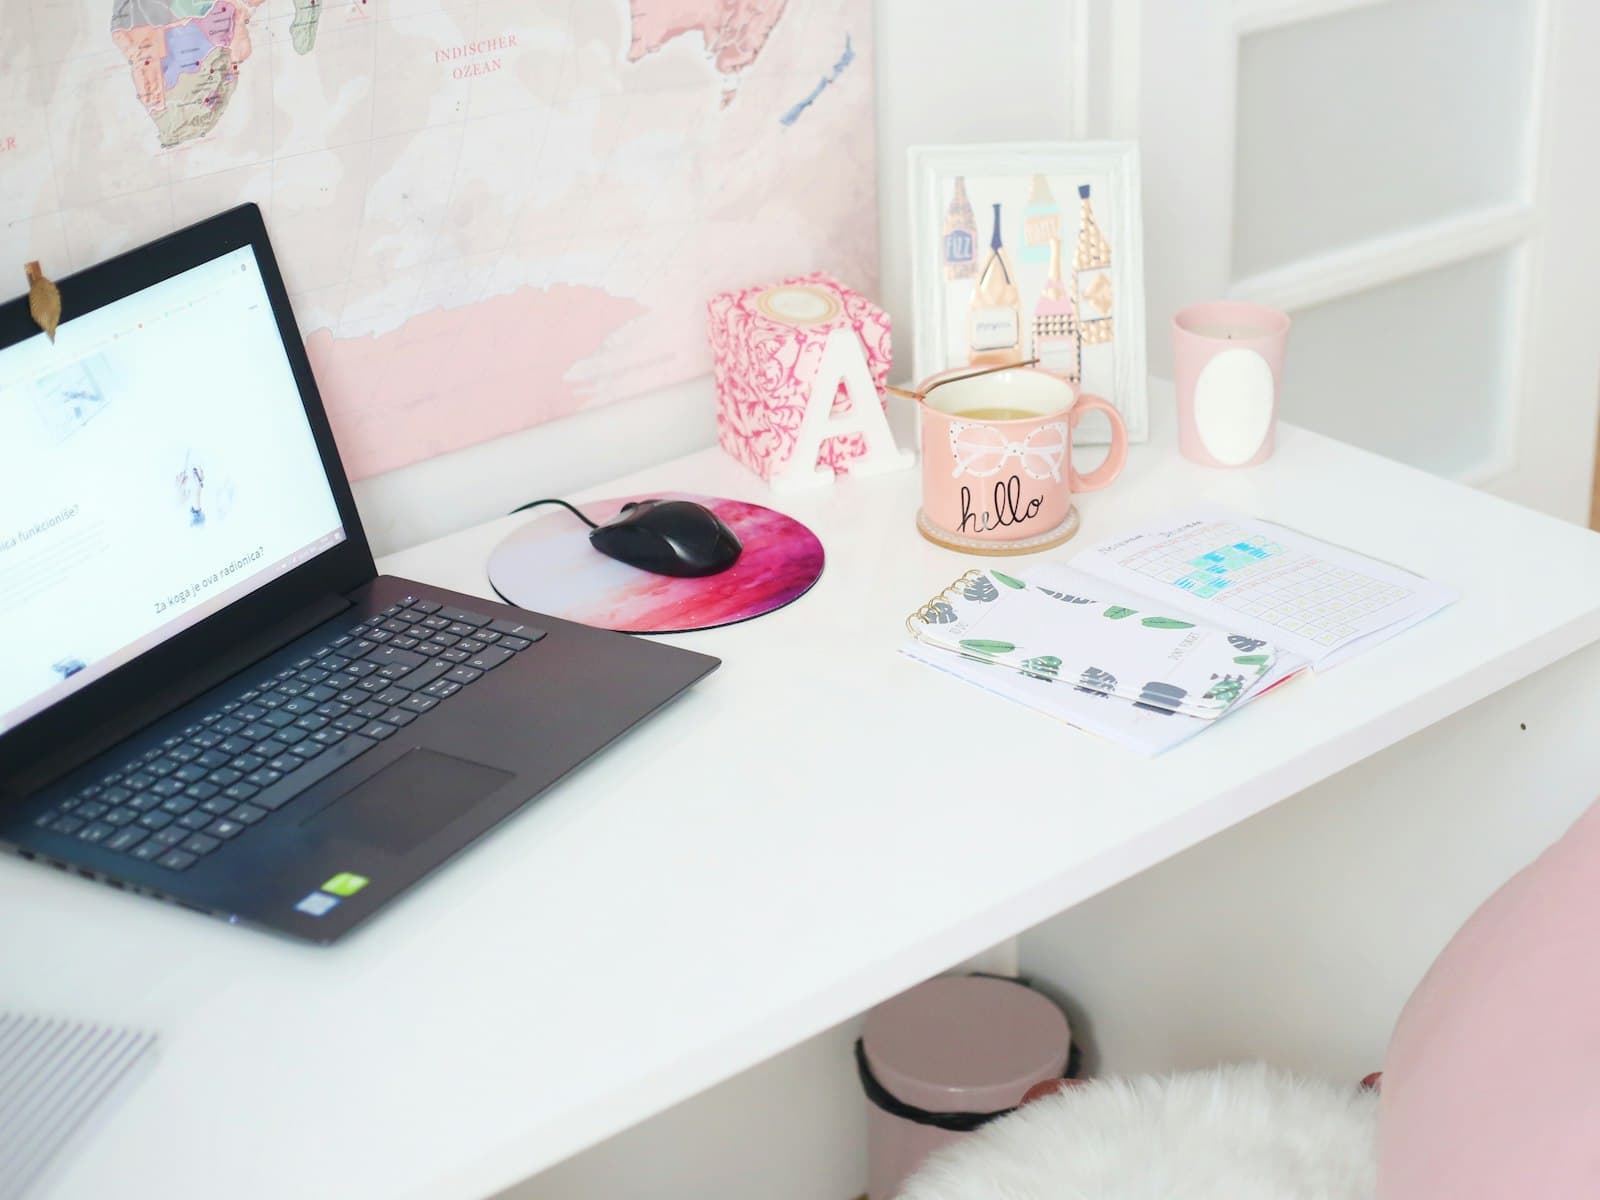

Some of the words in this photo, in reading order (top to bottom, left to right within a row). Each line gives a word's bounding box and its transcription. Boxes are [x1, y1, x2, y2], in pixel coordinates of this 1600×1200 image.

[433, 33, 518, 65] INDISCHER
[452, 58, 502, 80] OZEAN
[769, 327, 915, 490] A
[956, 475, 1044, 533] hello
[154, 602, 168, 614] Za
[167, 588, 192, 605] koga
[190, 582, 202, 598] je
[202, 572, 219, 588] ova
[218, 545, 266, 579] radionica?
